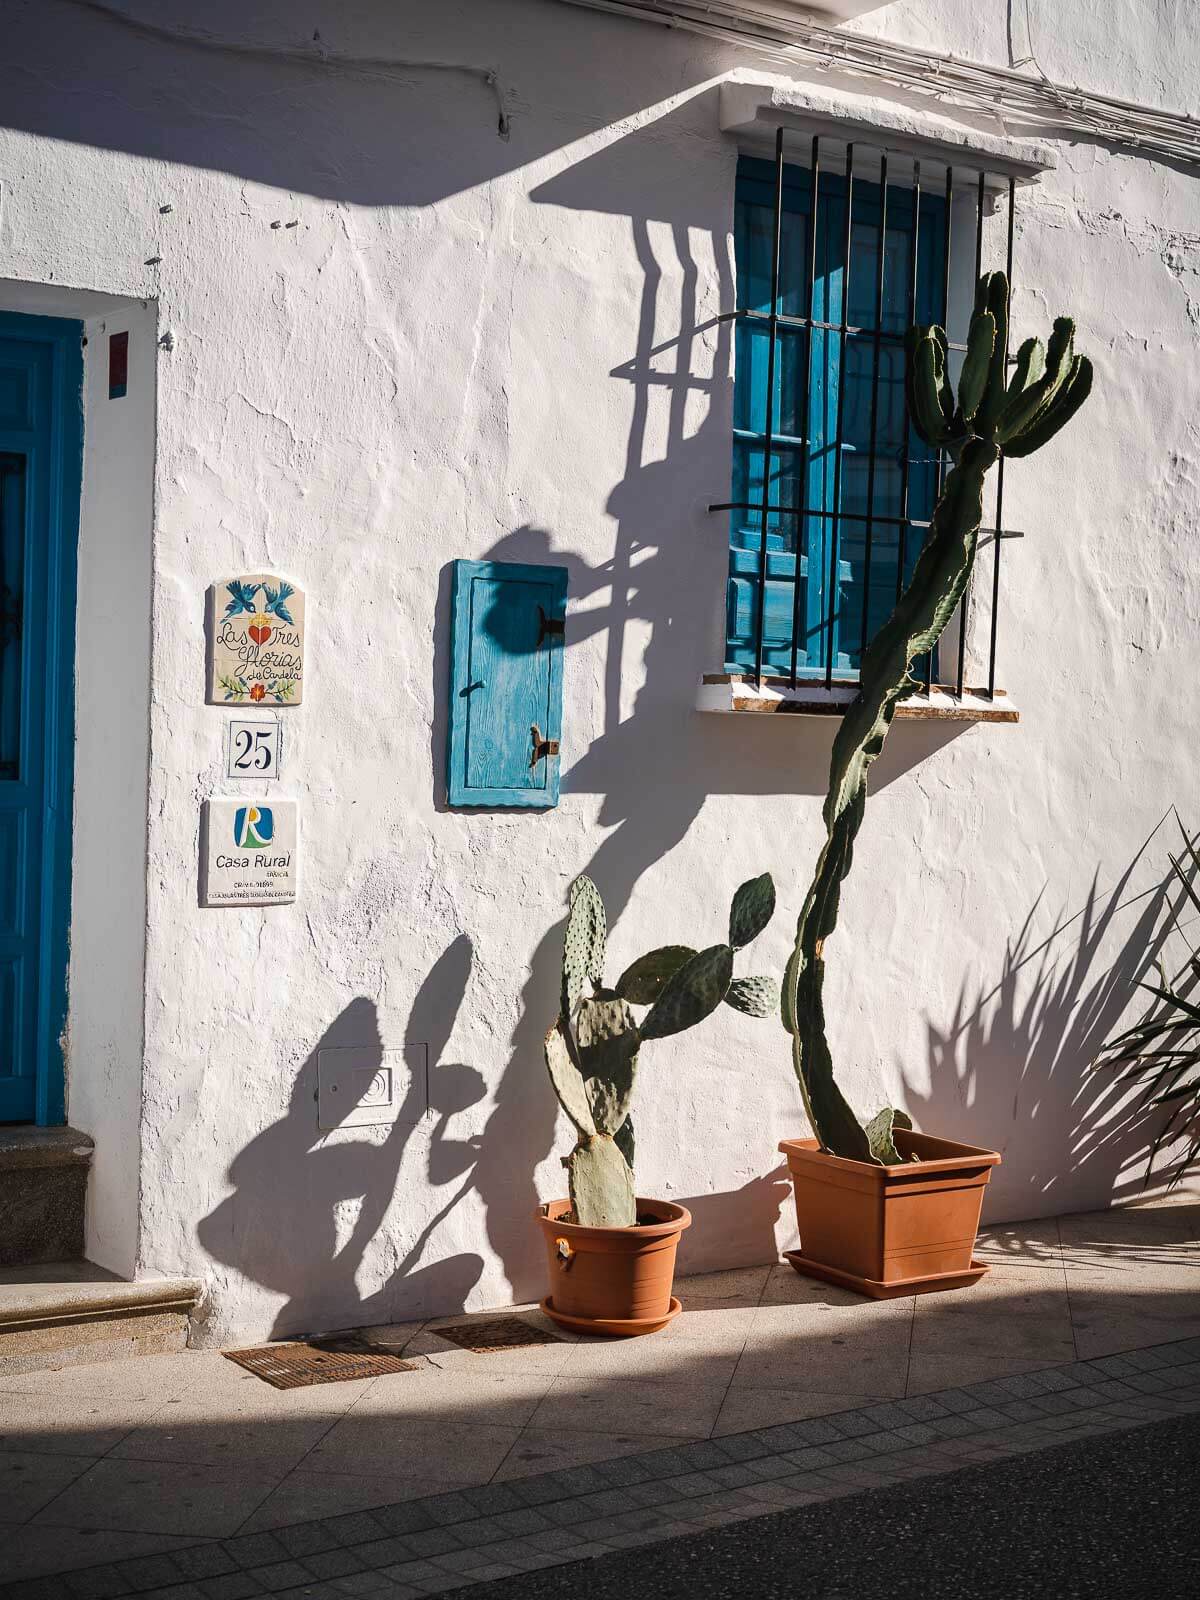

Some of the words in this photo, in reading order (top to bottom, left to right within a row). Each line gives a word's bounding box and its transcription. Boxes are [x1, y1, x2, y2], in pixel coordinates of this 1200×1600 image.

[217, 623, 248, 650] Las
[269, 624, 300, 647] Tres
[235, 730, 272, 769] 25
[216, 855, 249, 868] Casa
[254, 854, 291, 868] Rural
